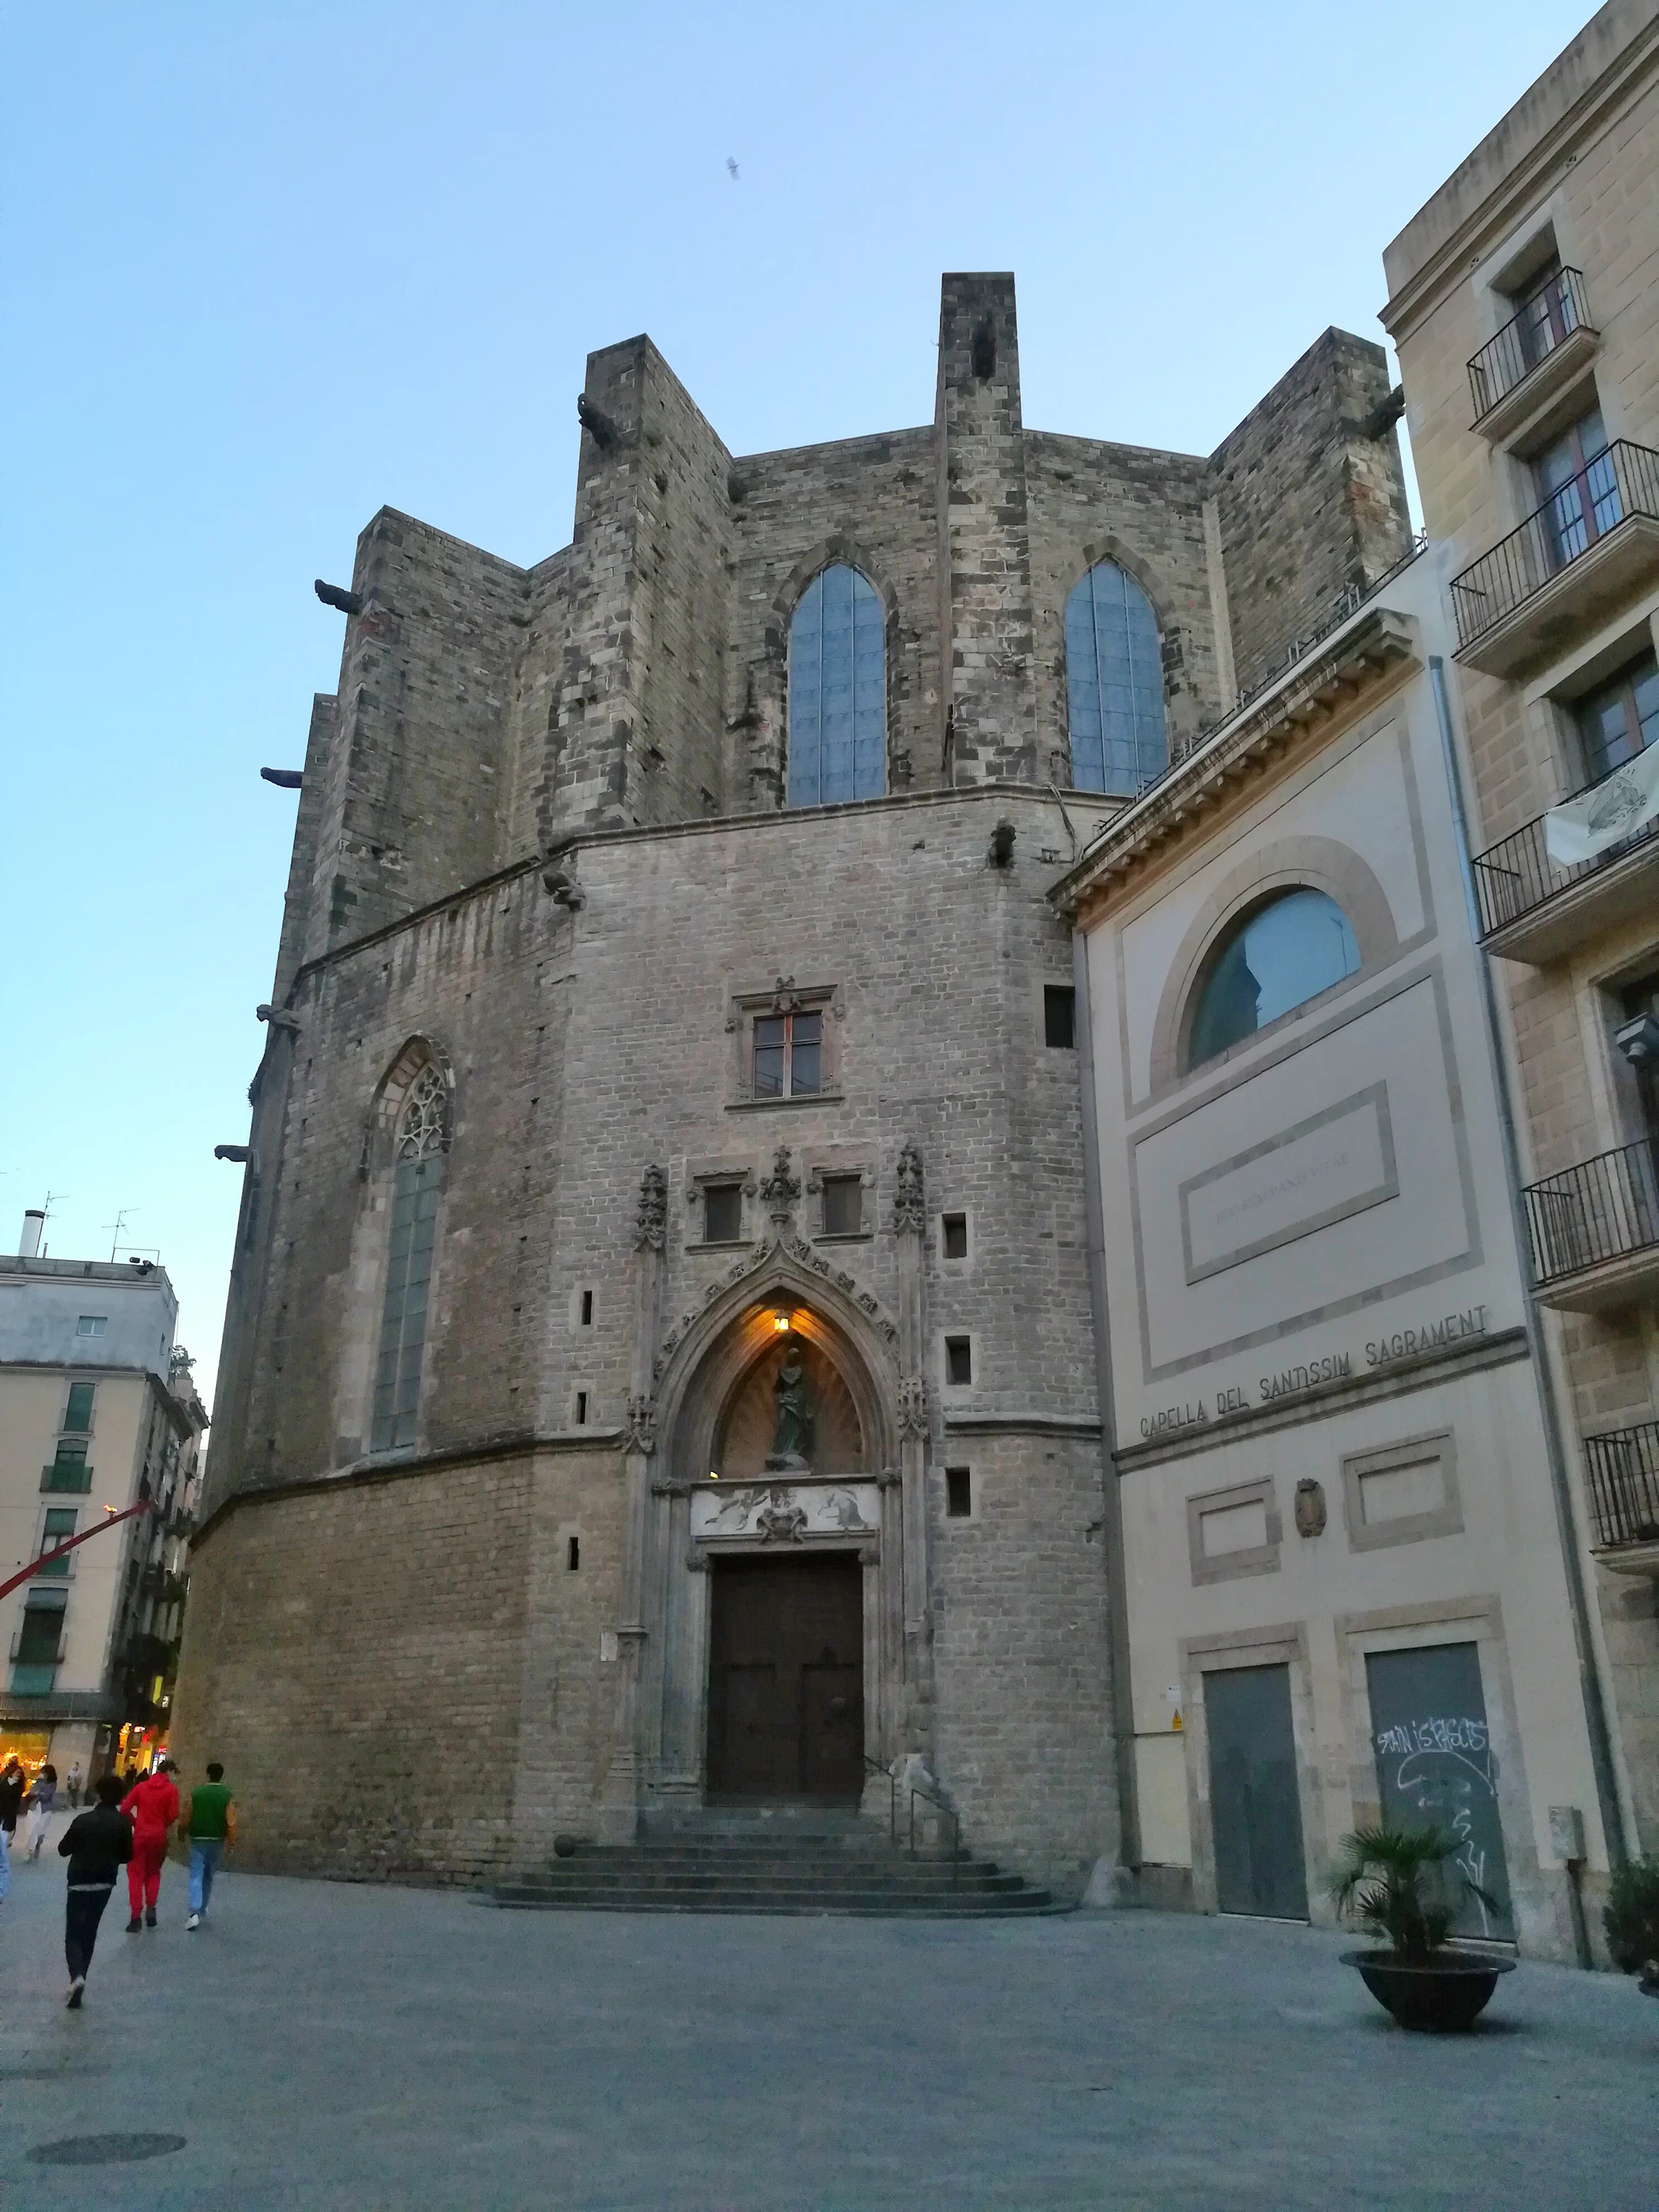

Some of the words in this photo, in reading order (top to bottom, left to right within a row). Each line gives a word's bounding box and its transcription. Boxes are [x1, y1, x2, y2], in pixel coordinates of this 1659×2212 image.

[1141, 1400, 1209, 1437] CAPELLA
[1217, 1386, 1249, 1414] DEL
[1366, 1305, 1486, 1365] SAGRAMENT
